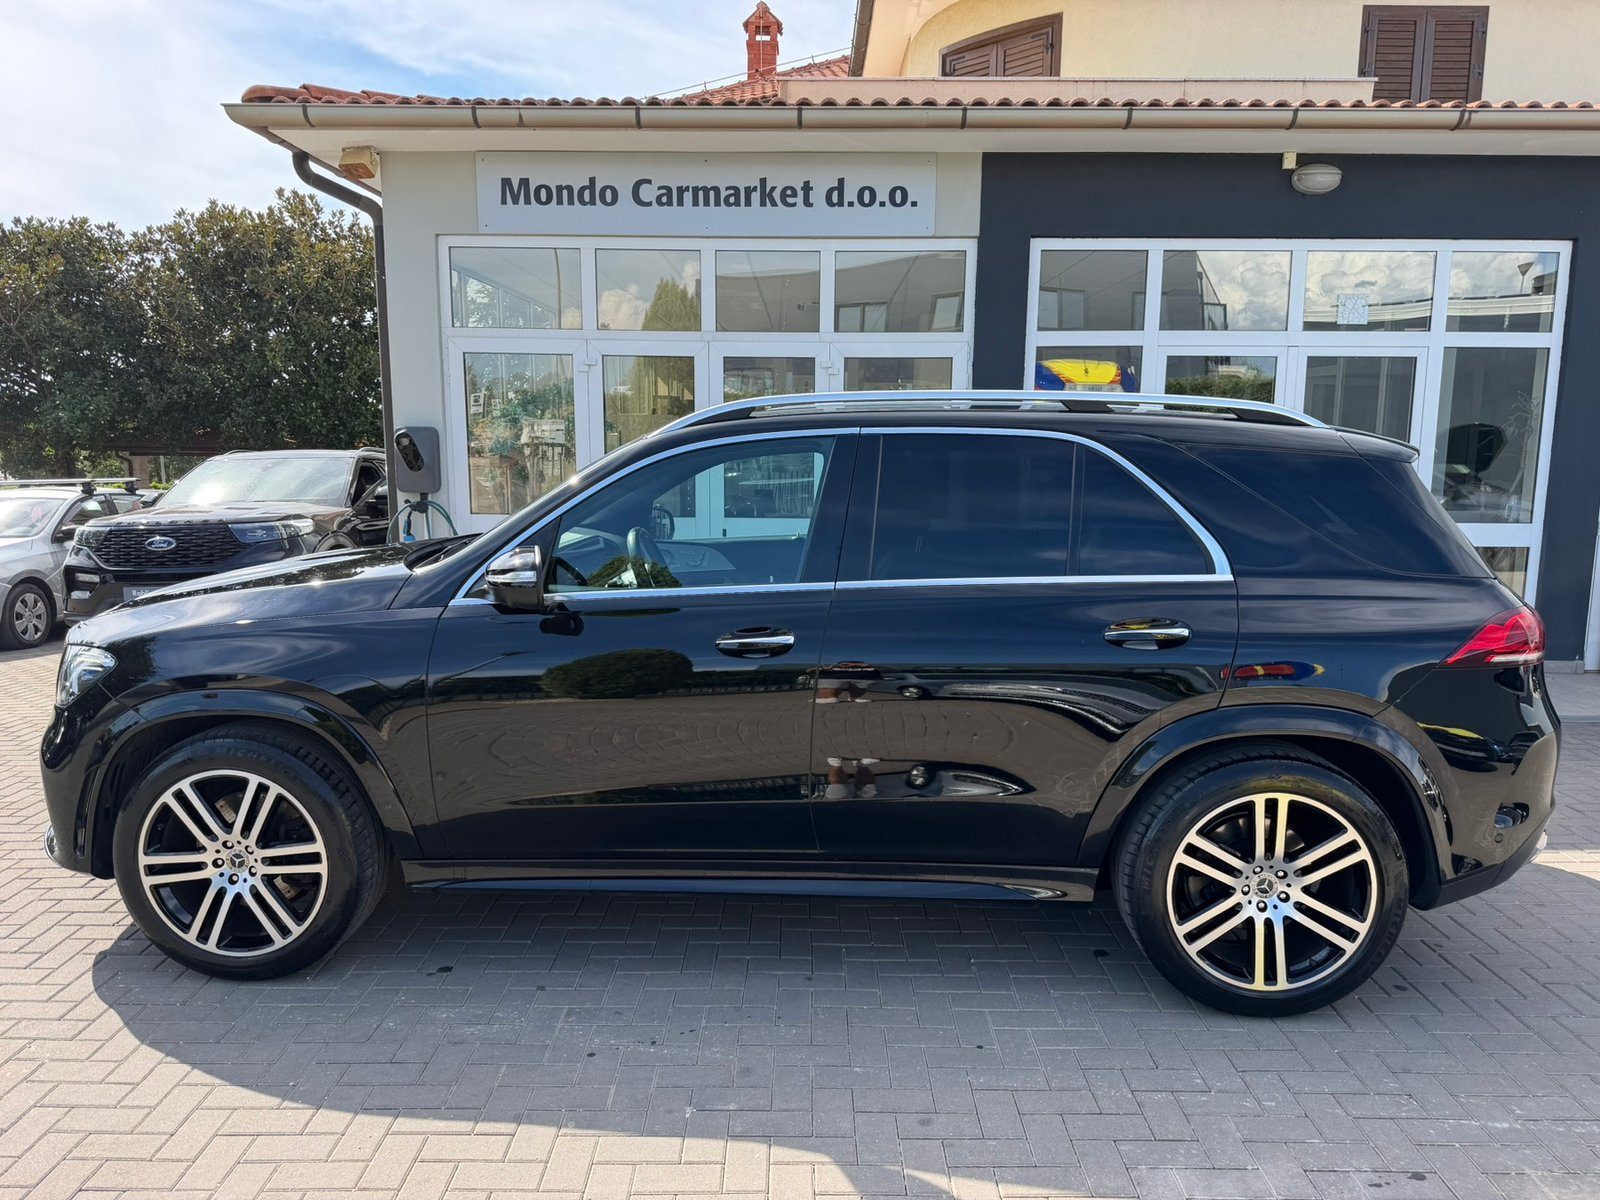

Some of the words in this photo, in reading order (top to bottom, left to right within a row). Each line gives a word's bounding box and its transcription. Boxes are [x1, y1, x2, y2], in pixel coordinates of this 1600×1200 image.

[500, 176, 619, 207] Mondo
[631, 176, 814, 208] Carmarket
[825, 177, 918, 208] d.o.o.
